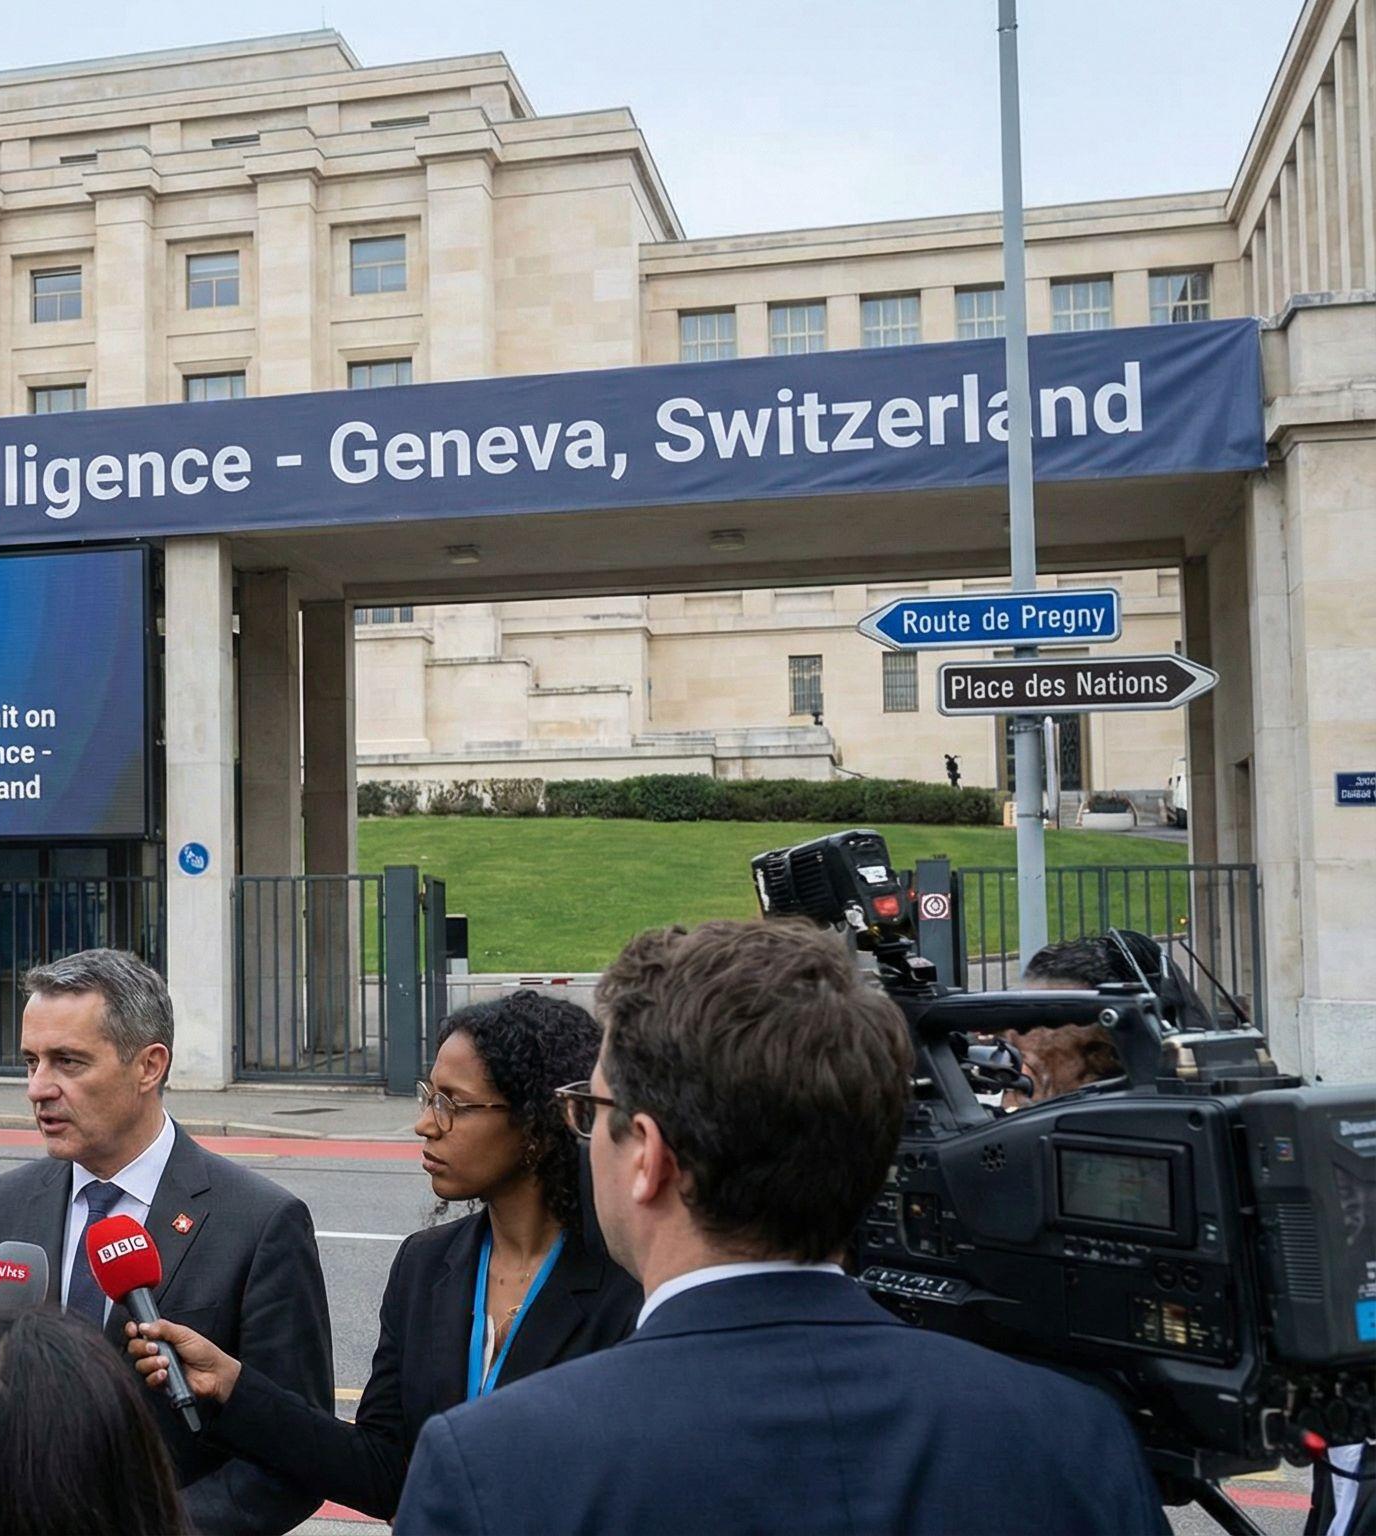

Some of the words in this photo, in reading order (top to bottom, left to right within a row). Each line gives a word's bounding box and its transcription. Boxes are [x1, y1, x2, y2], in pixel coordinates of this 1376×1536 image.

[276, 454, 302, 467] -
[329, 420, 627, 484] Geneva,
[903, 610, 971, 634] Route
[982, 608, 1010, 631] de
[1022, 605, 1105, 634] Pregny
[951, 675, 1014, 699] Place
[1025, 674, 1066, 697] des
[1077, 671, 1168, 695] Nations
[25, 709, 56, 728] on
[100, 1236, 146, 1261] BBC
